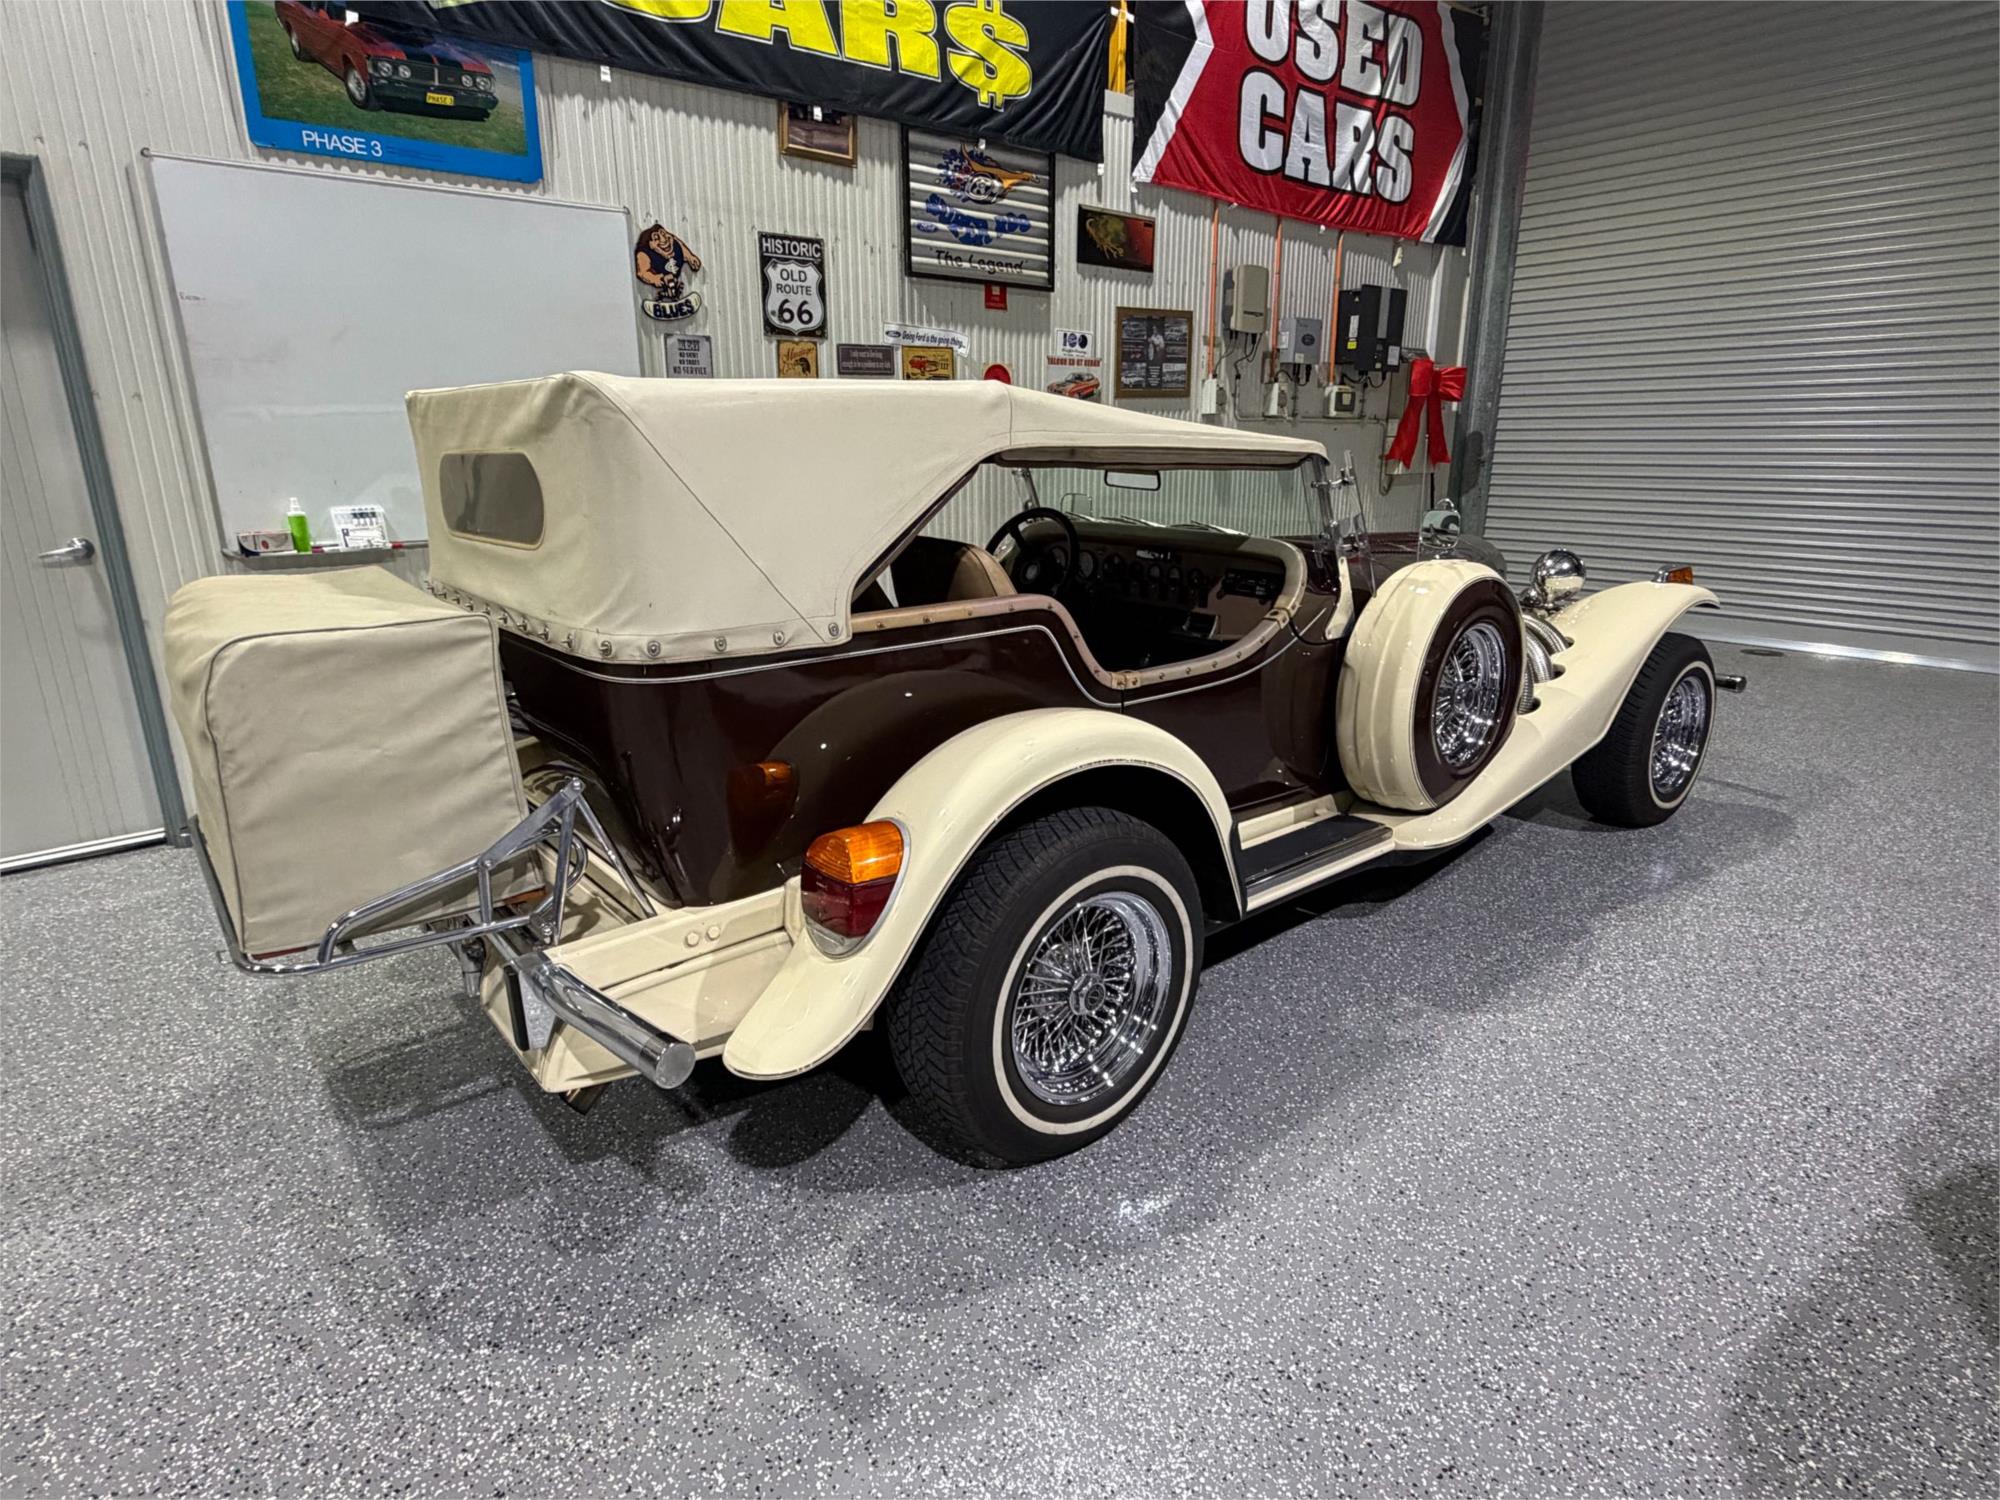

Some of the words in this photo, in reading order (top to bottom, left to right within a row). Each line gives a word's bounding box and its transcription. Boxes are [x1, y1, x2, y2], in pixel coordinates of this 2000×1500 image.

[605, 0, 1033, 112] AR$
[1247, 0, 1424, 107] USED
[428, 95, 448, 104] PHASE
[302, 130, 367, 155] PHASE
[370, 141, 383, 157] 3
[1239, 70, 1415, 203] CARS
[762, 237, 821, 258] HISTORIC
[780, 268, 808, 283] OLD
[776, 283, 812, 296] ROUTE
[653, 299, 694, 319] BLUES
[778, 298, 814, 325] 66
[902, 330, 915, 343] Going
[916, 332, 926, 342] Ford
[682, 366, 707, 375] SERVICE
